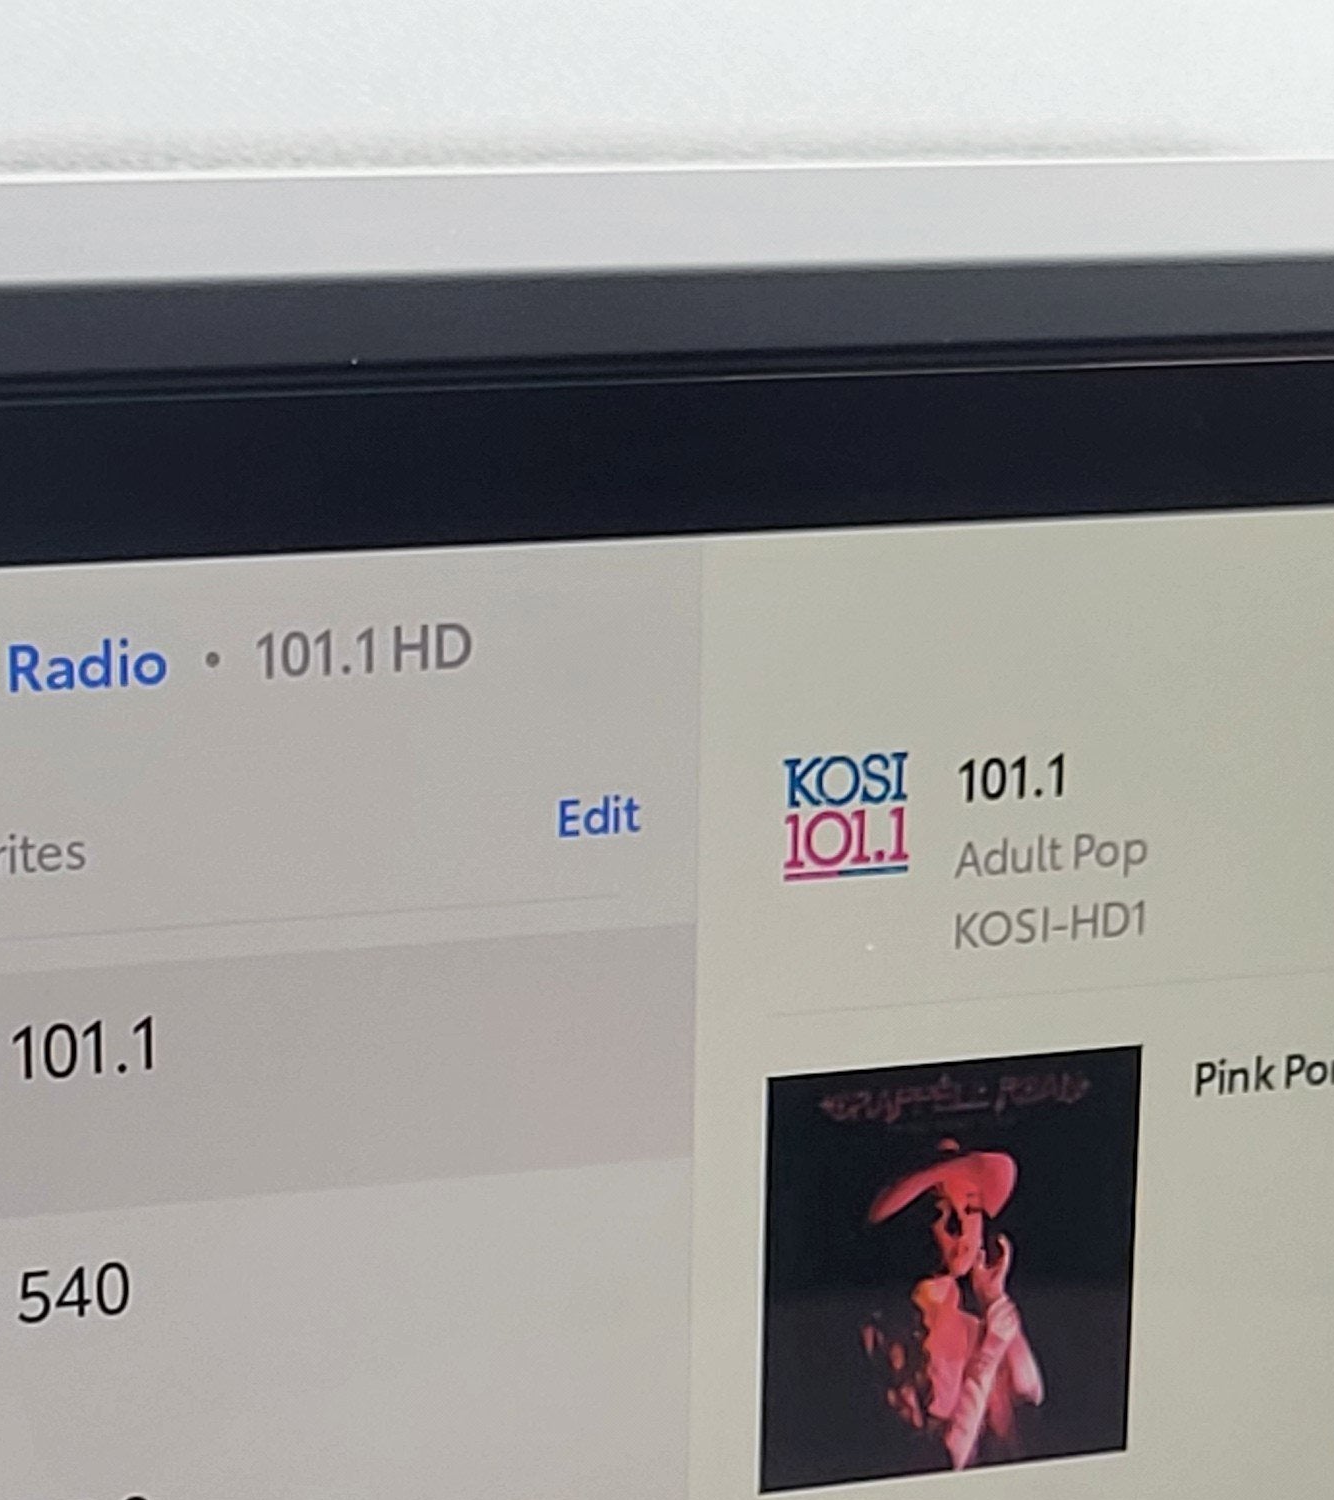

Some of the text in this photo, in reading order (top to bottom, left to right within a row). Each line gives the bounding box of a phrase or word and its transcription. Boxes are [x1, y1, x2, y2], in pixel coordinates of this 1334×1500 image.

[8, 623, 472, 693] Radio 101.1 HD
[784, 752, 909, 808] KOSI
[958, 753, 1065, 803] 101.1
[557, 795, 641, 837] Edit
[784, 807, 909, 870] 101.1
[954, 833, 1148, 879] Adult Pop
[954, 900, 1146, 950] KOSI-HD1
[12, 1015, 153, 1079] 101.1
[1194, 1056, 1276, 1097] Pink
[18, 1262, 131, 1323] 540
